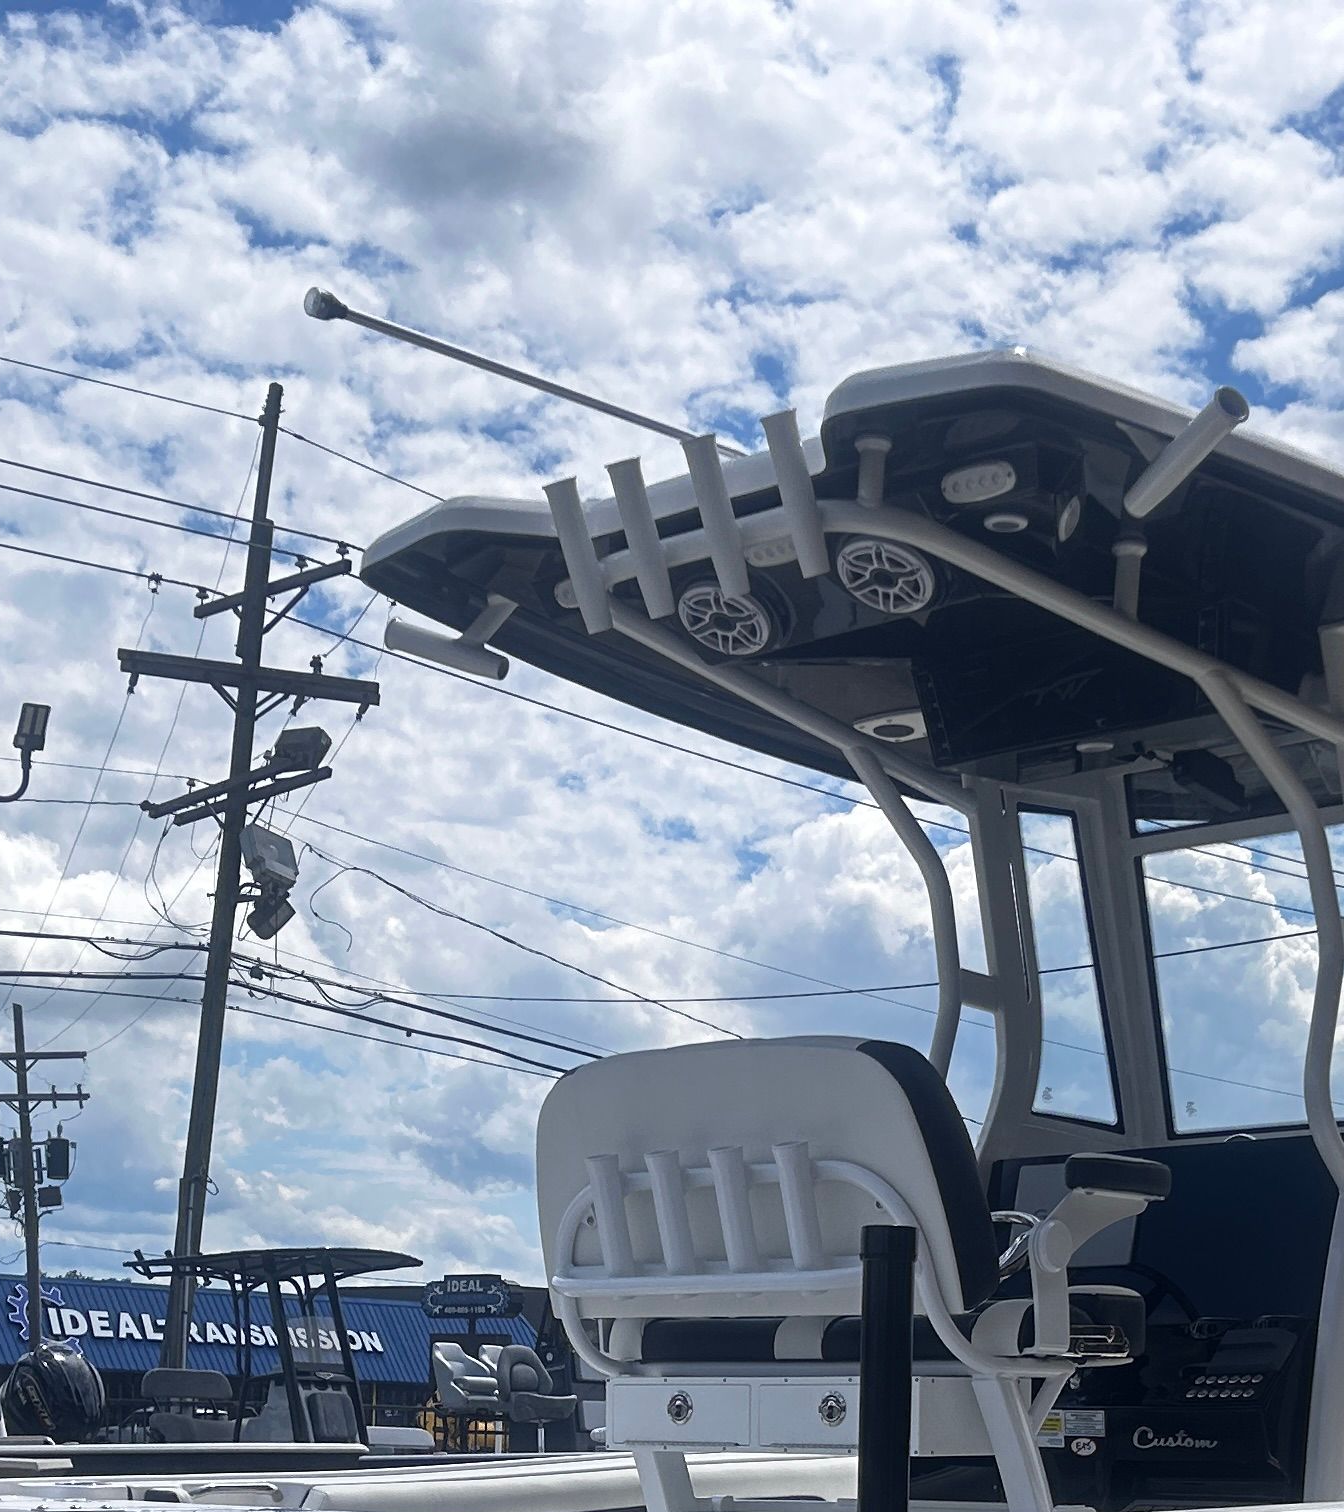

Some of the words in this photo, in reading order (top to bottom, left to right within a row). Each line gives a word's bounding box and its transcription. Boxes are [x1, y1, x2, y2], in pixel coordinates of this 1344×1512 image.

[446, 1280, 484, 1292] IDEAL
[47, 1307, 165, 1341] IDEAL
[156, 1319, 385, 1353] RANSMISSION
[1132, 1425, 1218, 1449] Custom
